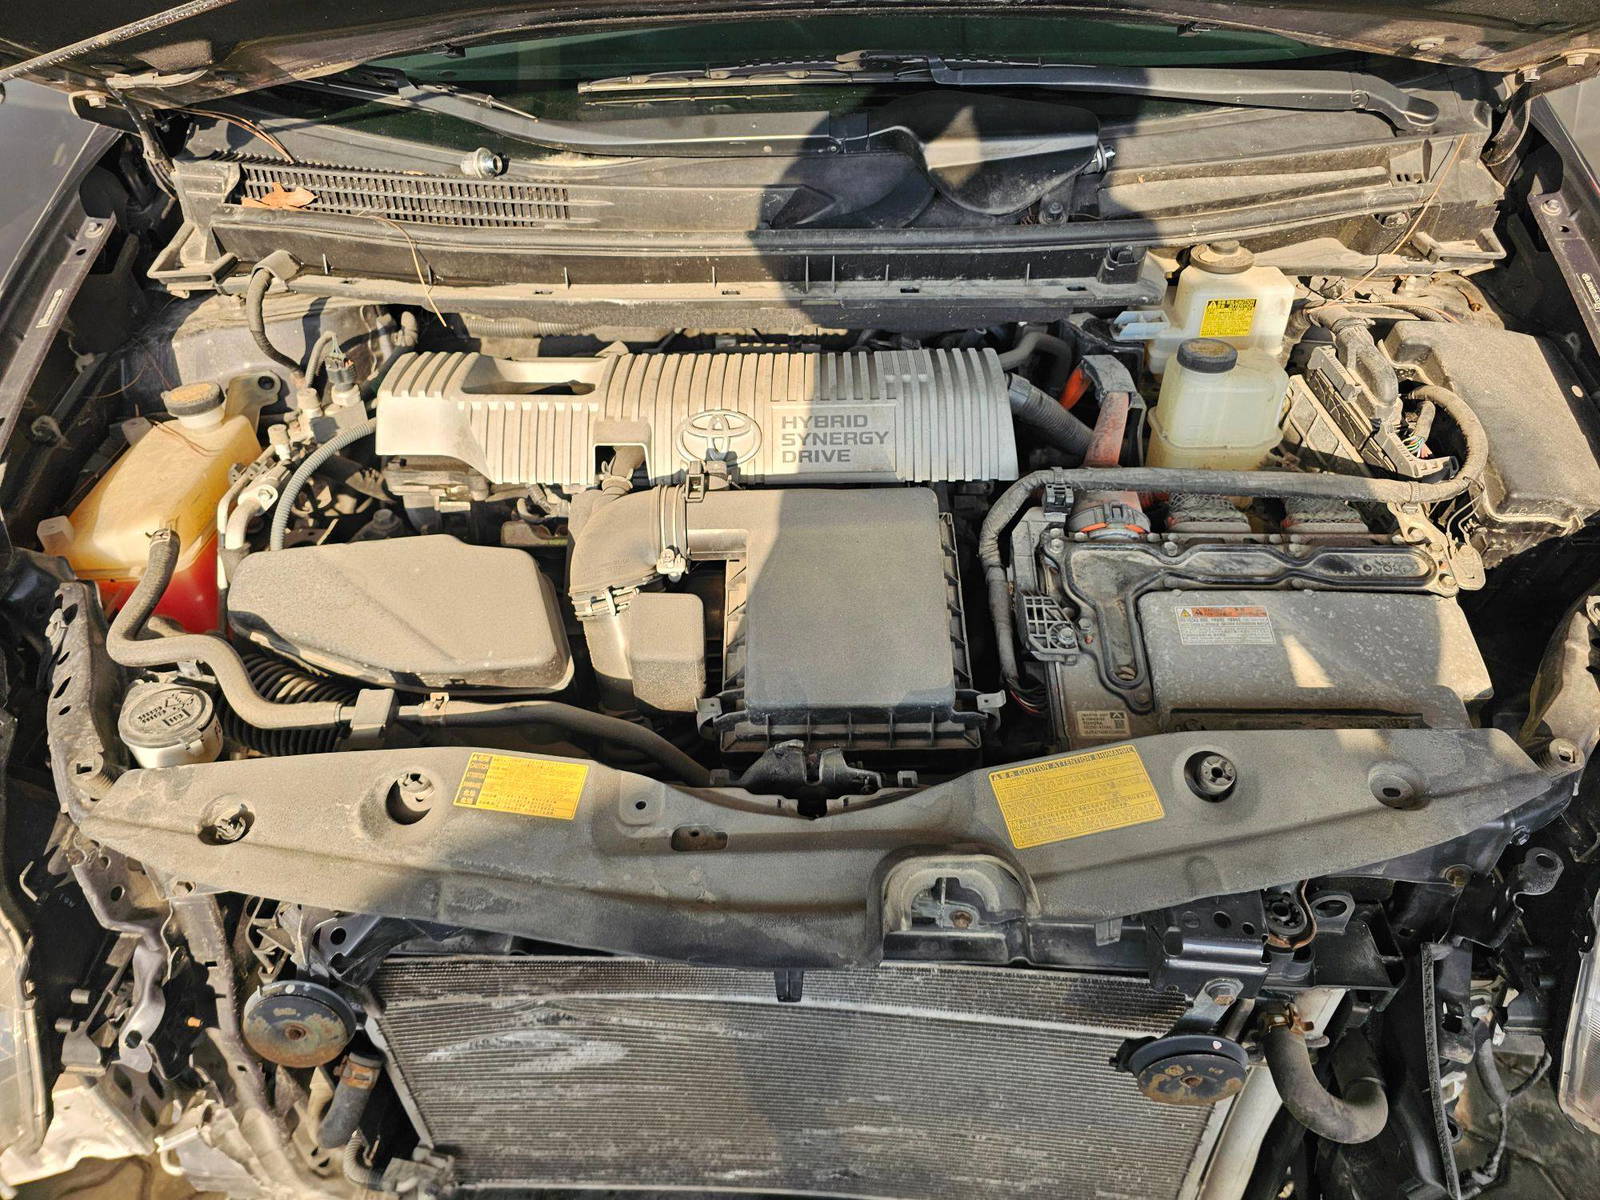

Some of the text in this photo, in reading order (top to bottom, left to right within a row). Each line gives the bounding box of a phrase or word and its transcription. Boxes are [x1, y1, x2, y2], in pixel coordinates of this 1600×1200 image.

[781, 414, 868, 429] HYBRID
[781, 431, 890, 447] SYNERGY
[781, 449, 851, 464] DRIVE
